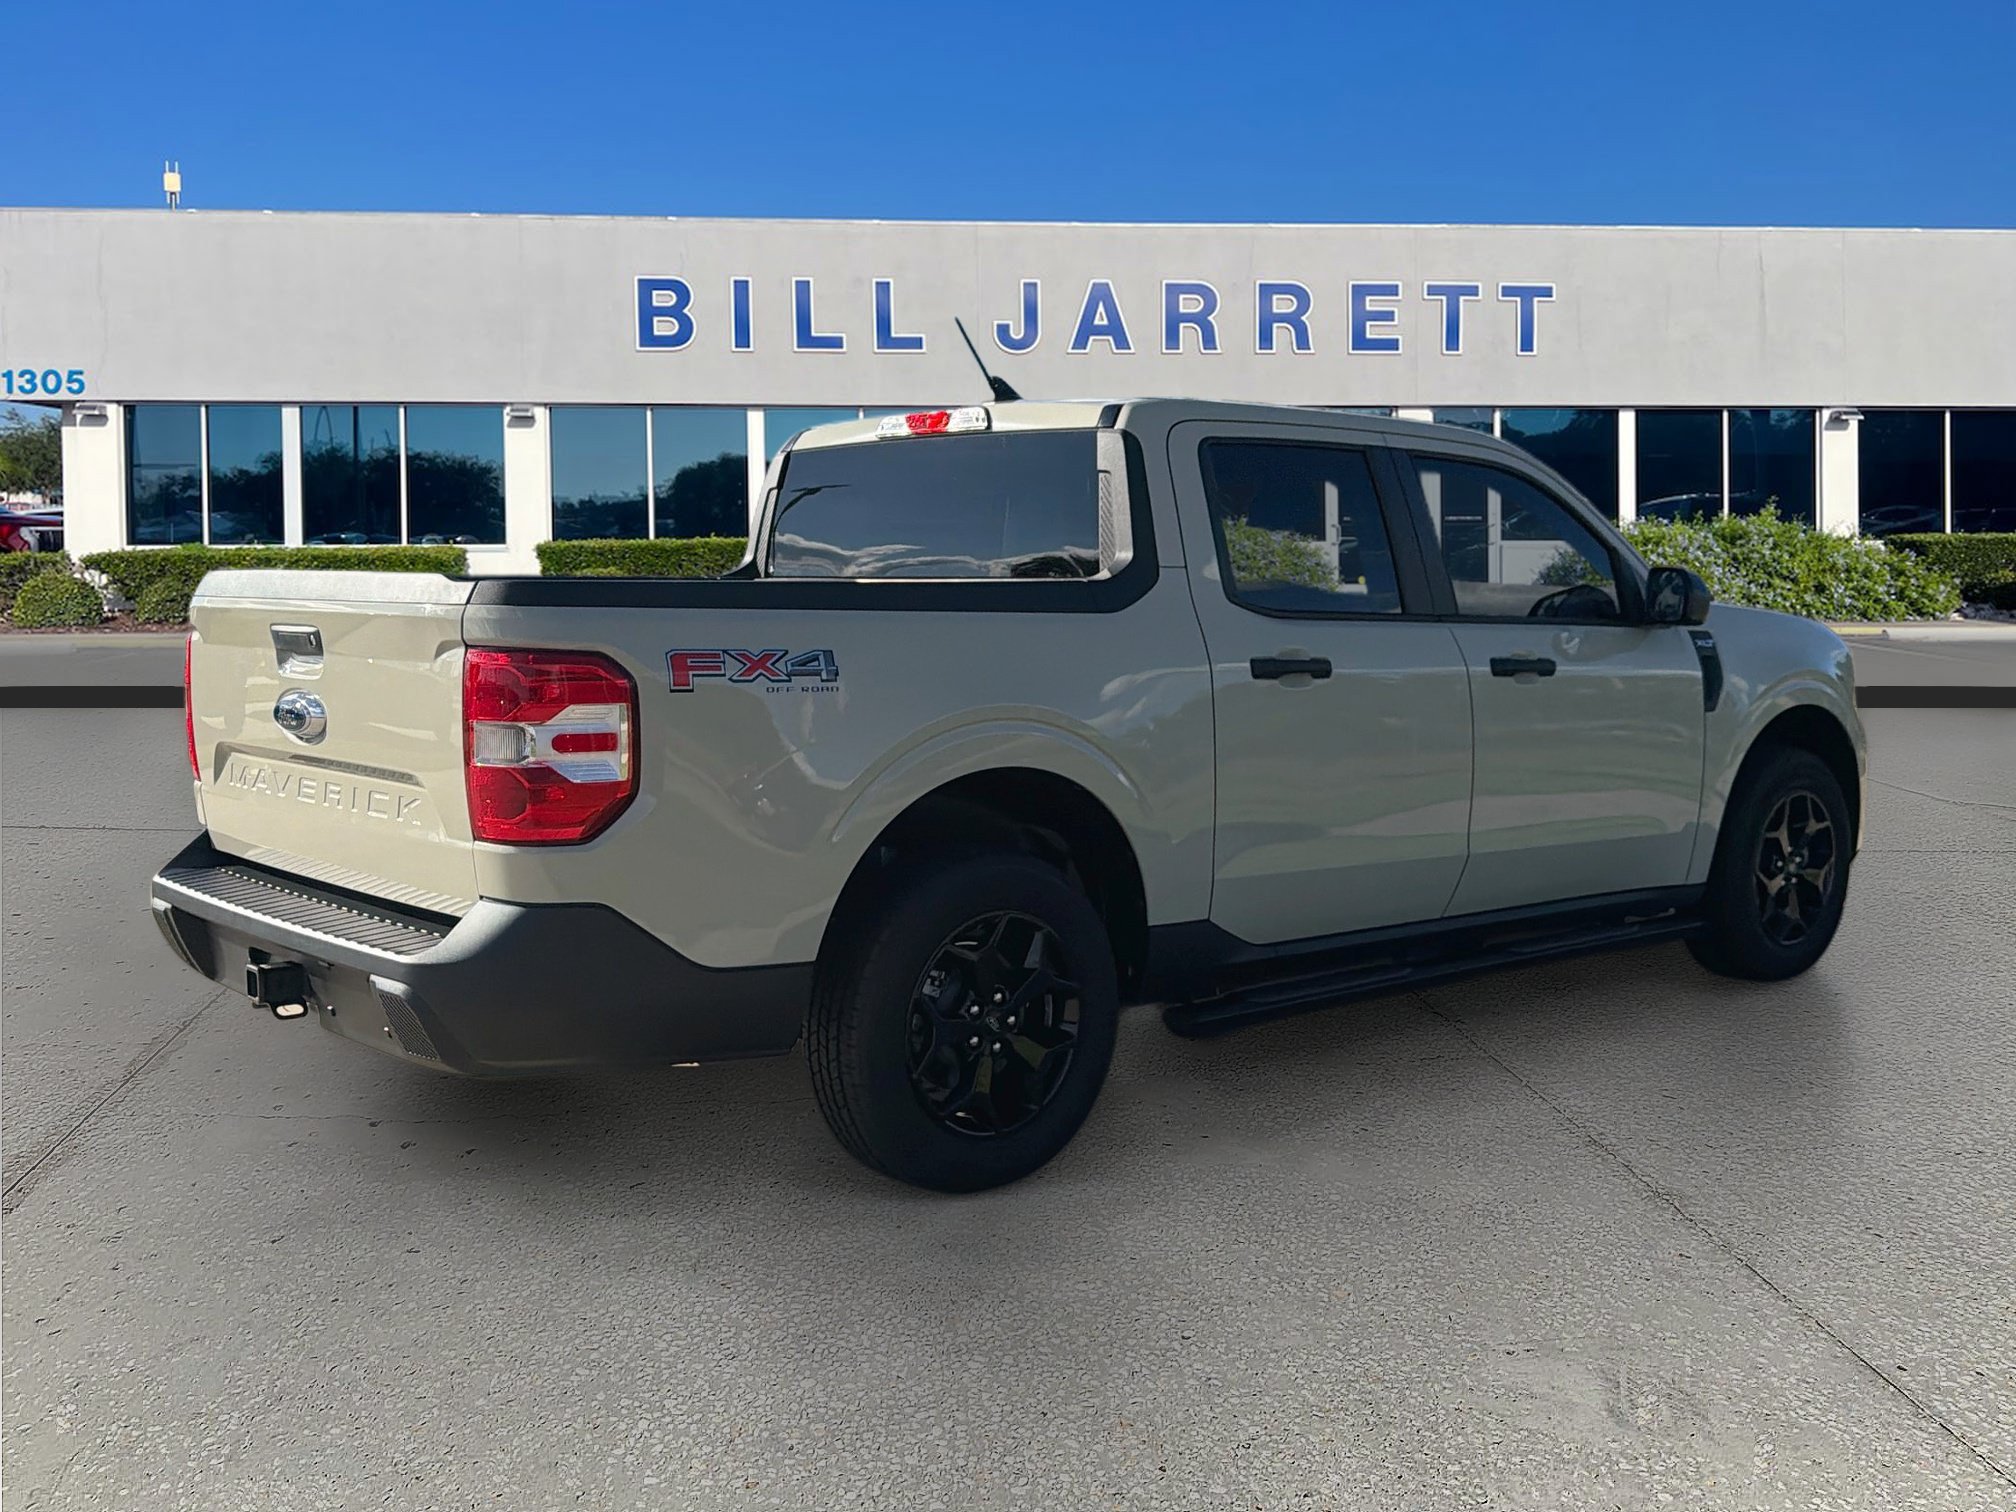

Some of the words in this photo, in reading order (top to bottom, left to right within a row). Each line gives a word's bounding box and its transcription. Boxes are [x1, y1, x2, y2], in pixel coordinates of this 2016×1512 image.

[634, 275, 926, 353] BILL
[993, 279, 1556, 357] JARRETT
[1, 369, 86, 395] 1305
[666, 649, 839, 692] FX4
[228, 762, 422, 826] MAVERICK
